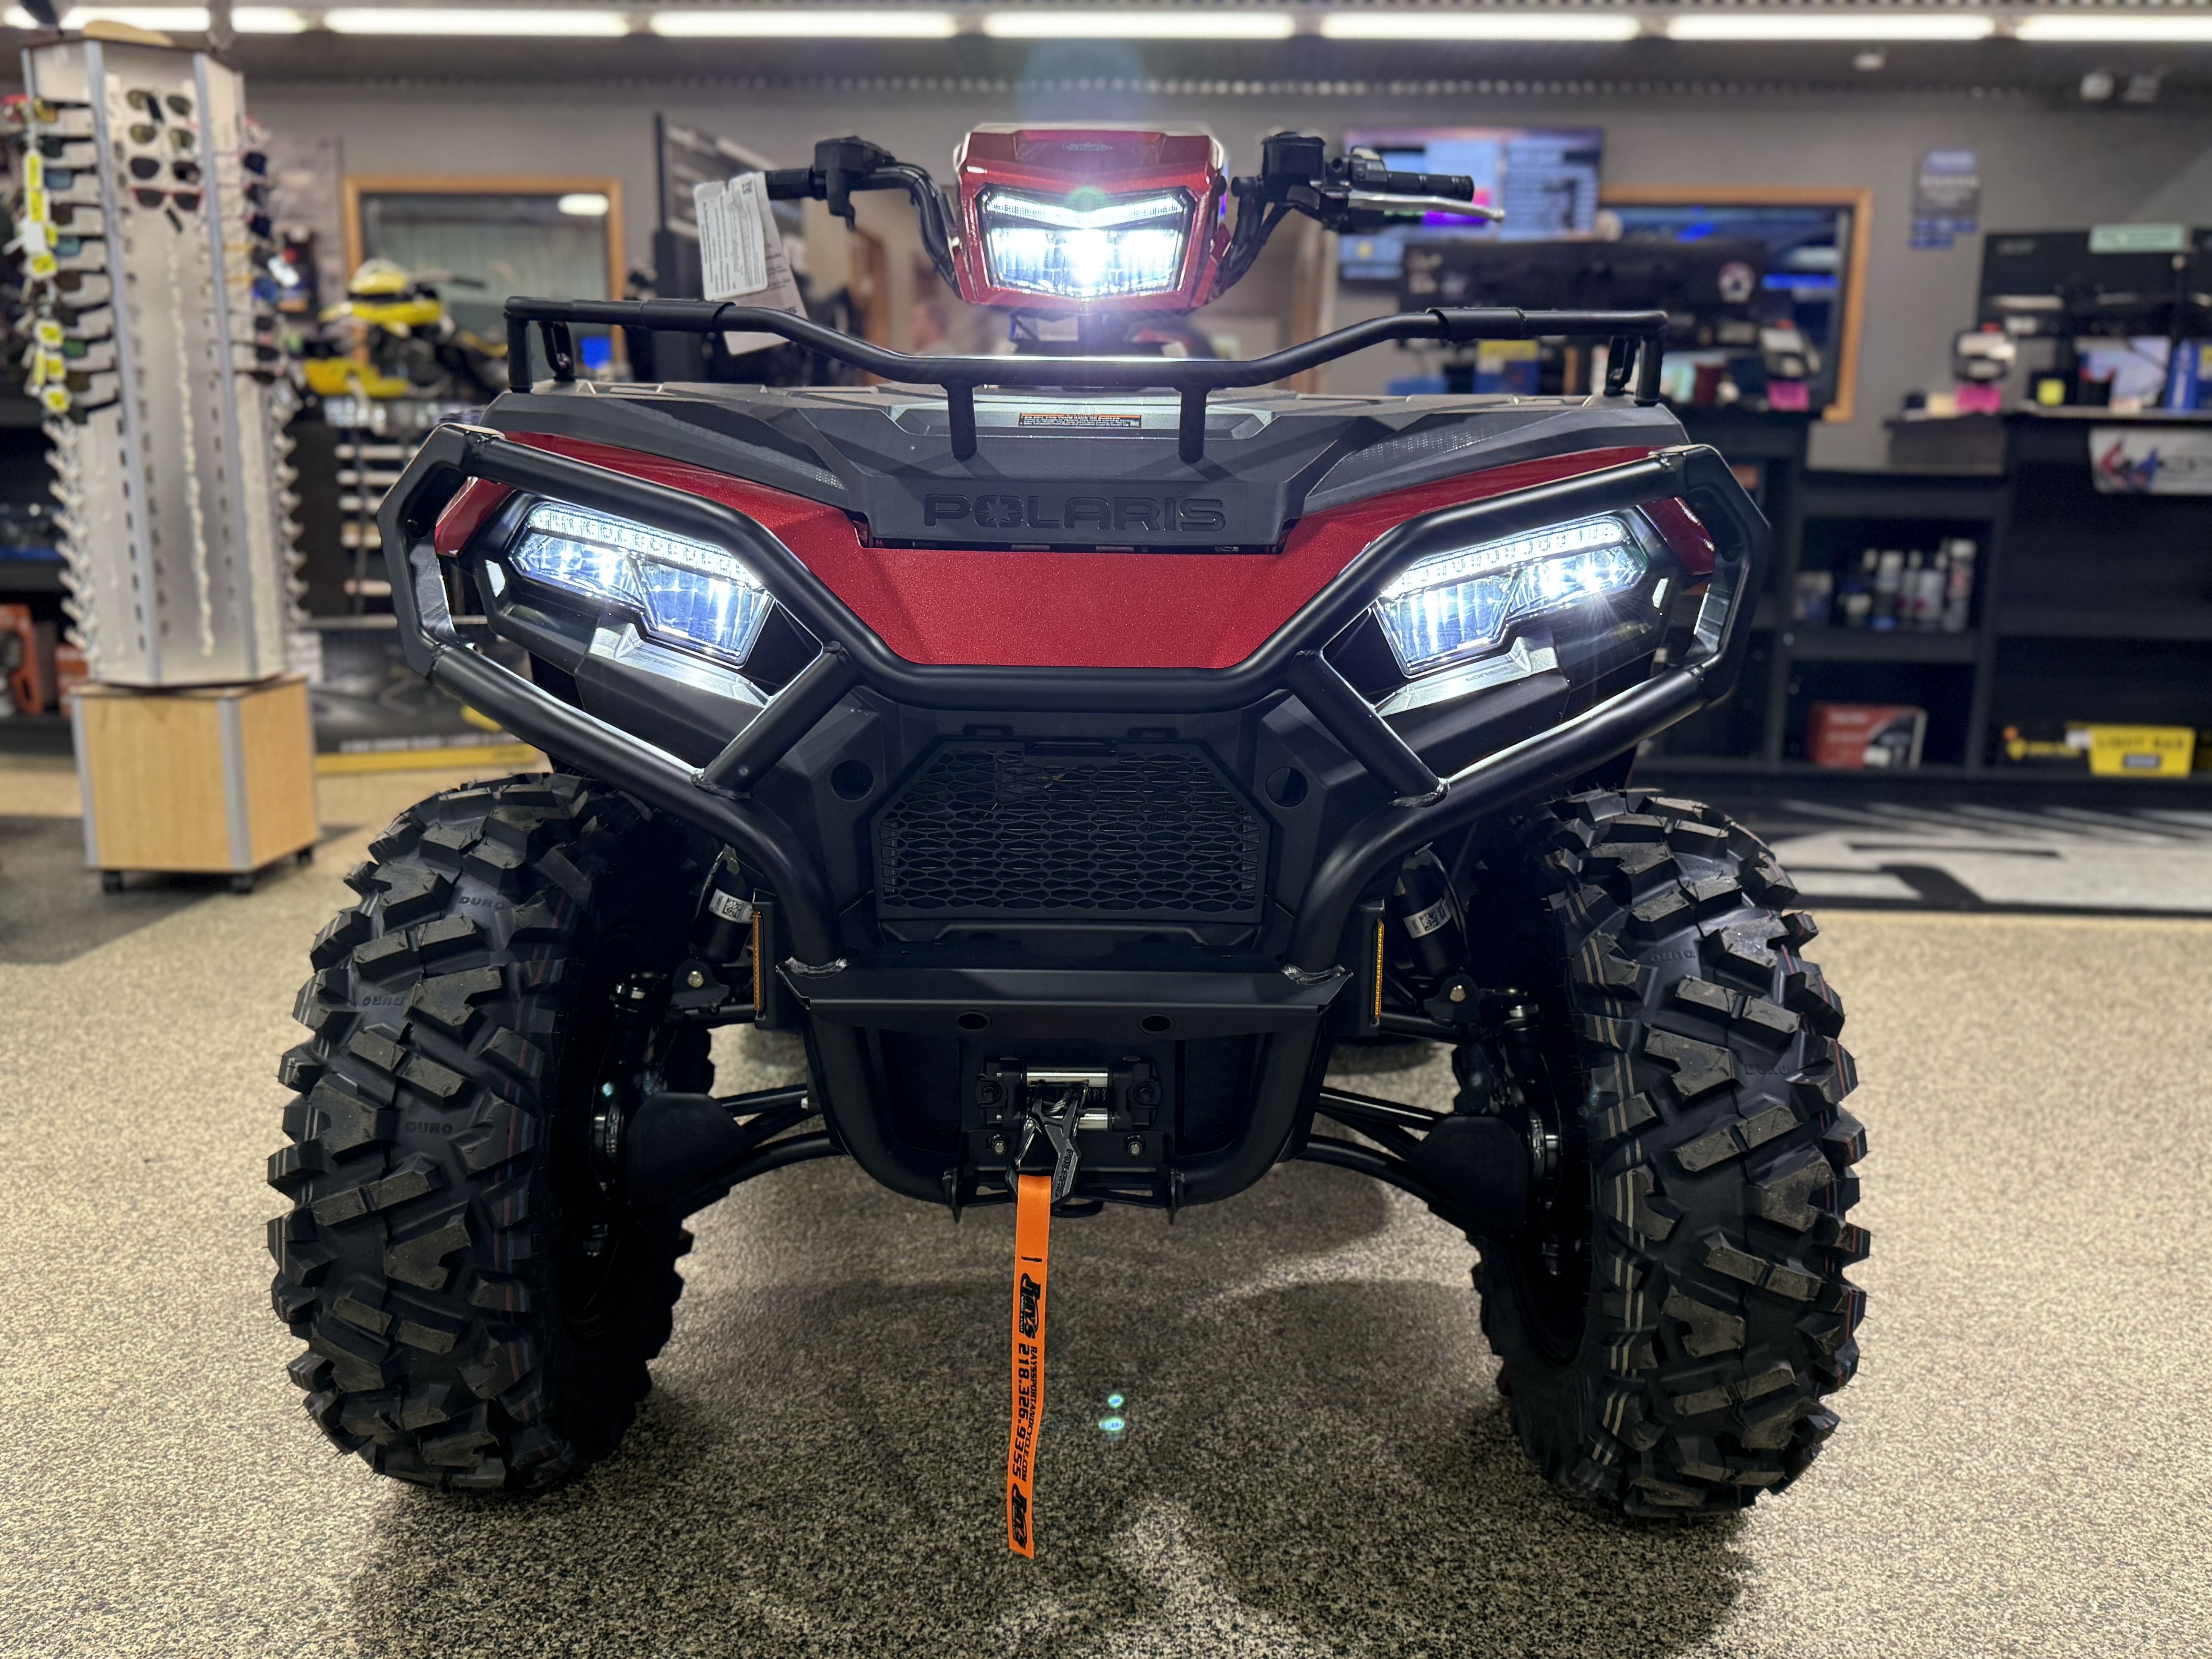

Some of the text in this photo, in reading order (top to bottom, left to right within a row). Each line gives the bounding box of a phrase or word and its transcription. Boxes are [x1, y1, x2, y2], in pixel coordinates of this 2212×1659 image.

[924, 494, 1225, 531] POLARIS
[459, 896, 505, 909] DURO
[362, 996, 403, 1006] DURO
[405, 1121, 453, 1134] DURO
[1012, 1343, 1030, 1479] 218.326.9355
[1022, 1346, 1037, 1482] RAYSSPORTANDCYCLE.COM
